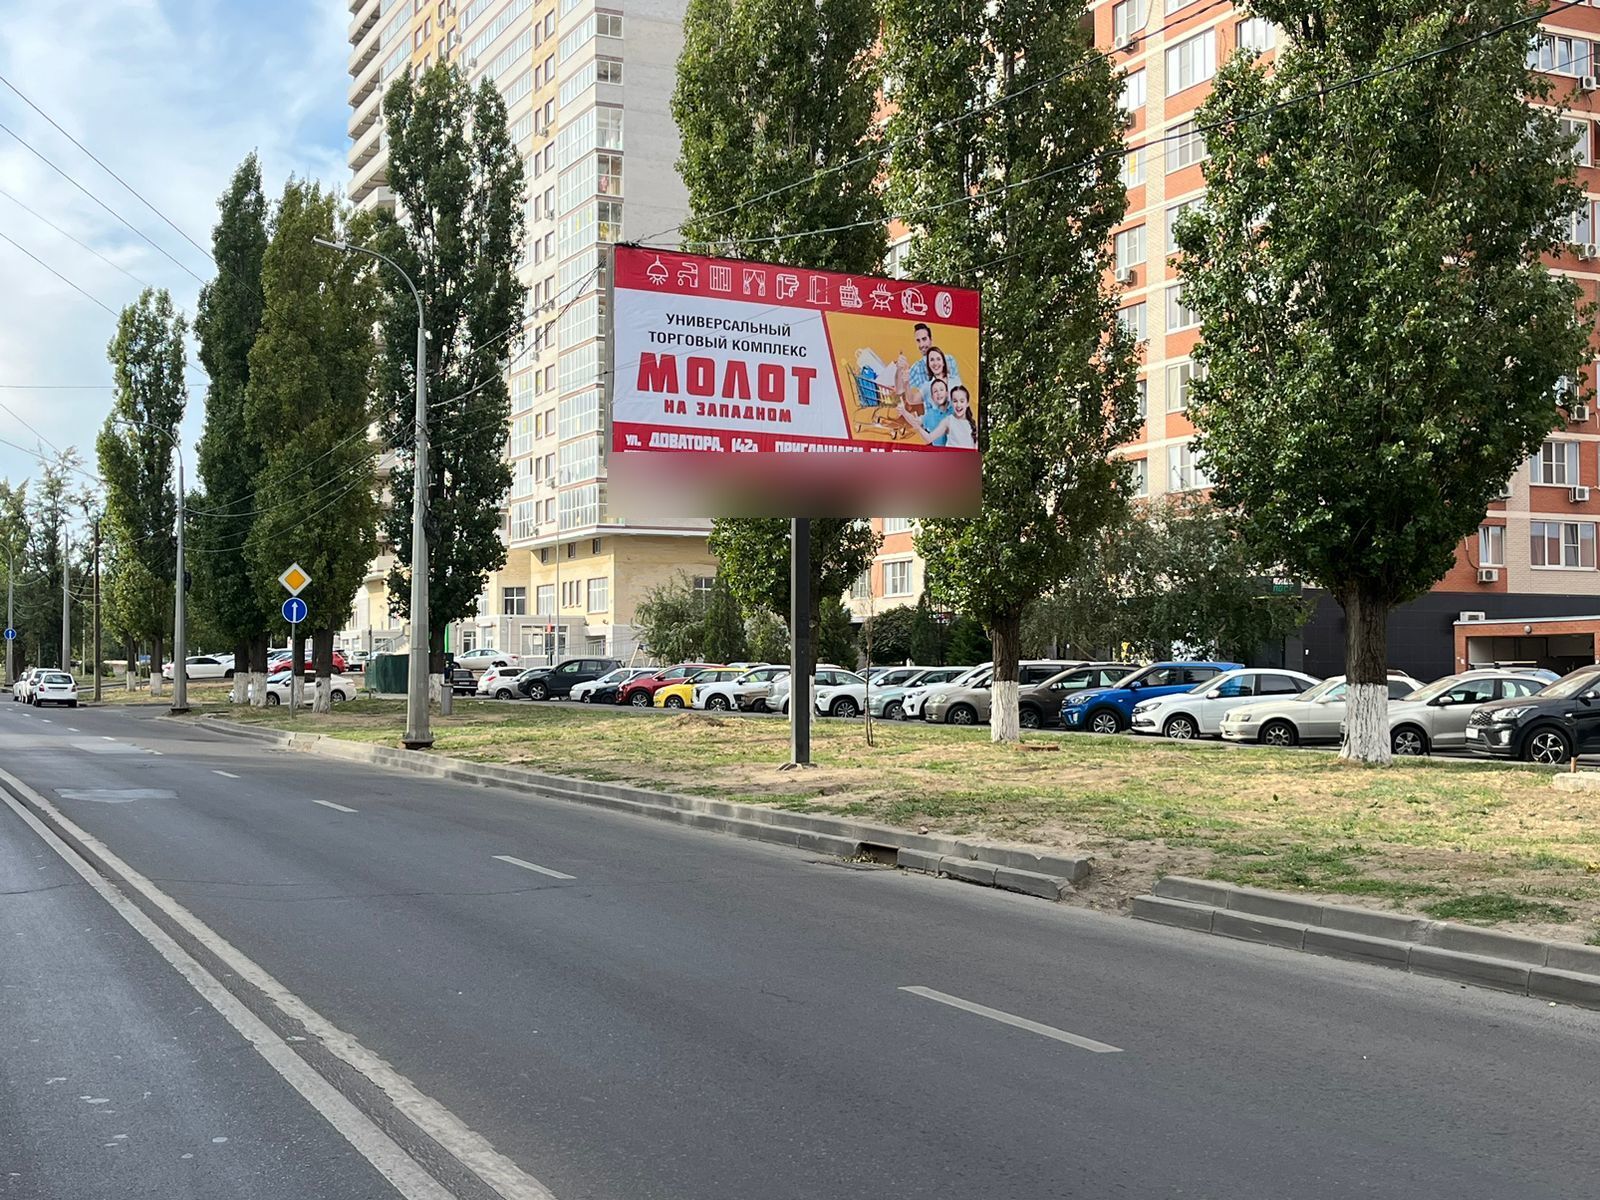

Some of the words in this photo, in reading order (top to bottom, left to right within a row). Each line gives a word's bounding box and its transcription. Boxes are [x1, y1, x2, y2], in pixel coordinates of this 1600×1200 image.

[666, 313, 791, 337] УНИВЕРСАЛЬНЫЙ
[648, 330, 727, 349] ТОРГОВЫЙ
[732, 340, 807, 358] КОМПЛЕКС
[637, 352, 817, 405] МОЛОТ
[664, 399, 687, 415] НА
[696, 402, 792, 423] ЗАПАДНОМ
[649, 432, 724, 452] ДОВАТОРА,
